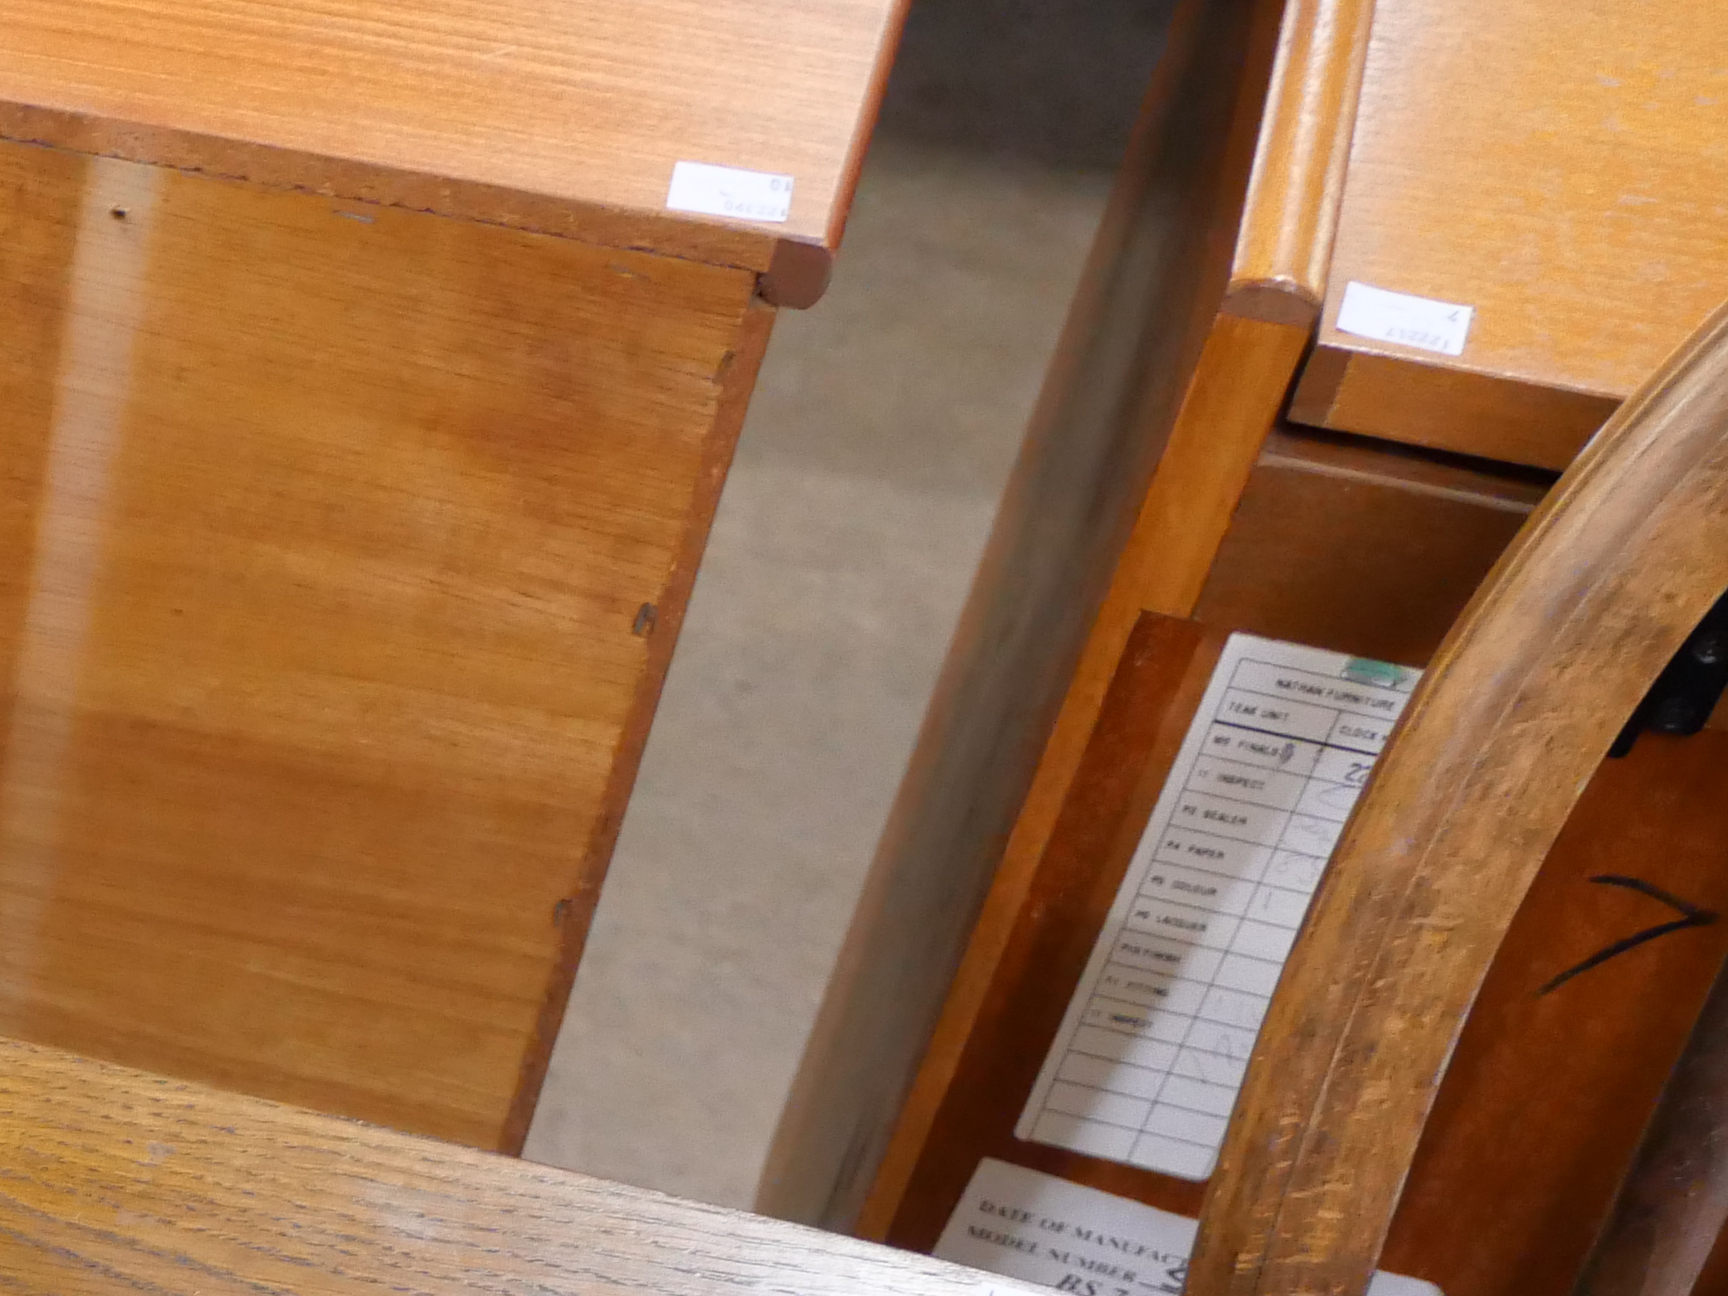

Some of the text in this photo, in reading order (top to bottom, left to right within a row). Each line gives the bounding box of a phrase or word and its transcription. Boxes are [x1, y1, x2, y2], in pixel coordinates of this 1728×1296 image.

[1275, 678, 1395, 711] NATHAN FURNITURE
[979, 1200, 1035, 1223] DATE
[1040, 1218, 1068, 1233] OF
[967, 1224, 1040, 1253] MODEL
[1048, 1248, 1137, 1283] NUMBER
